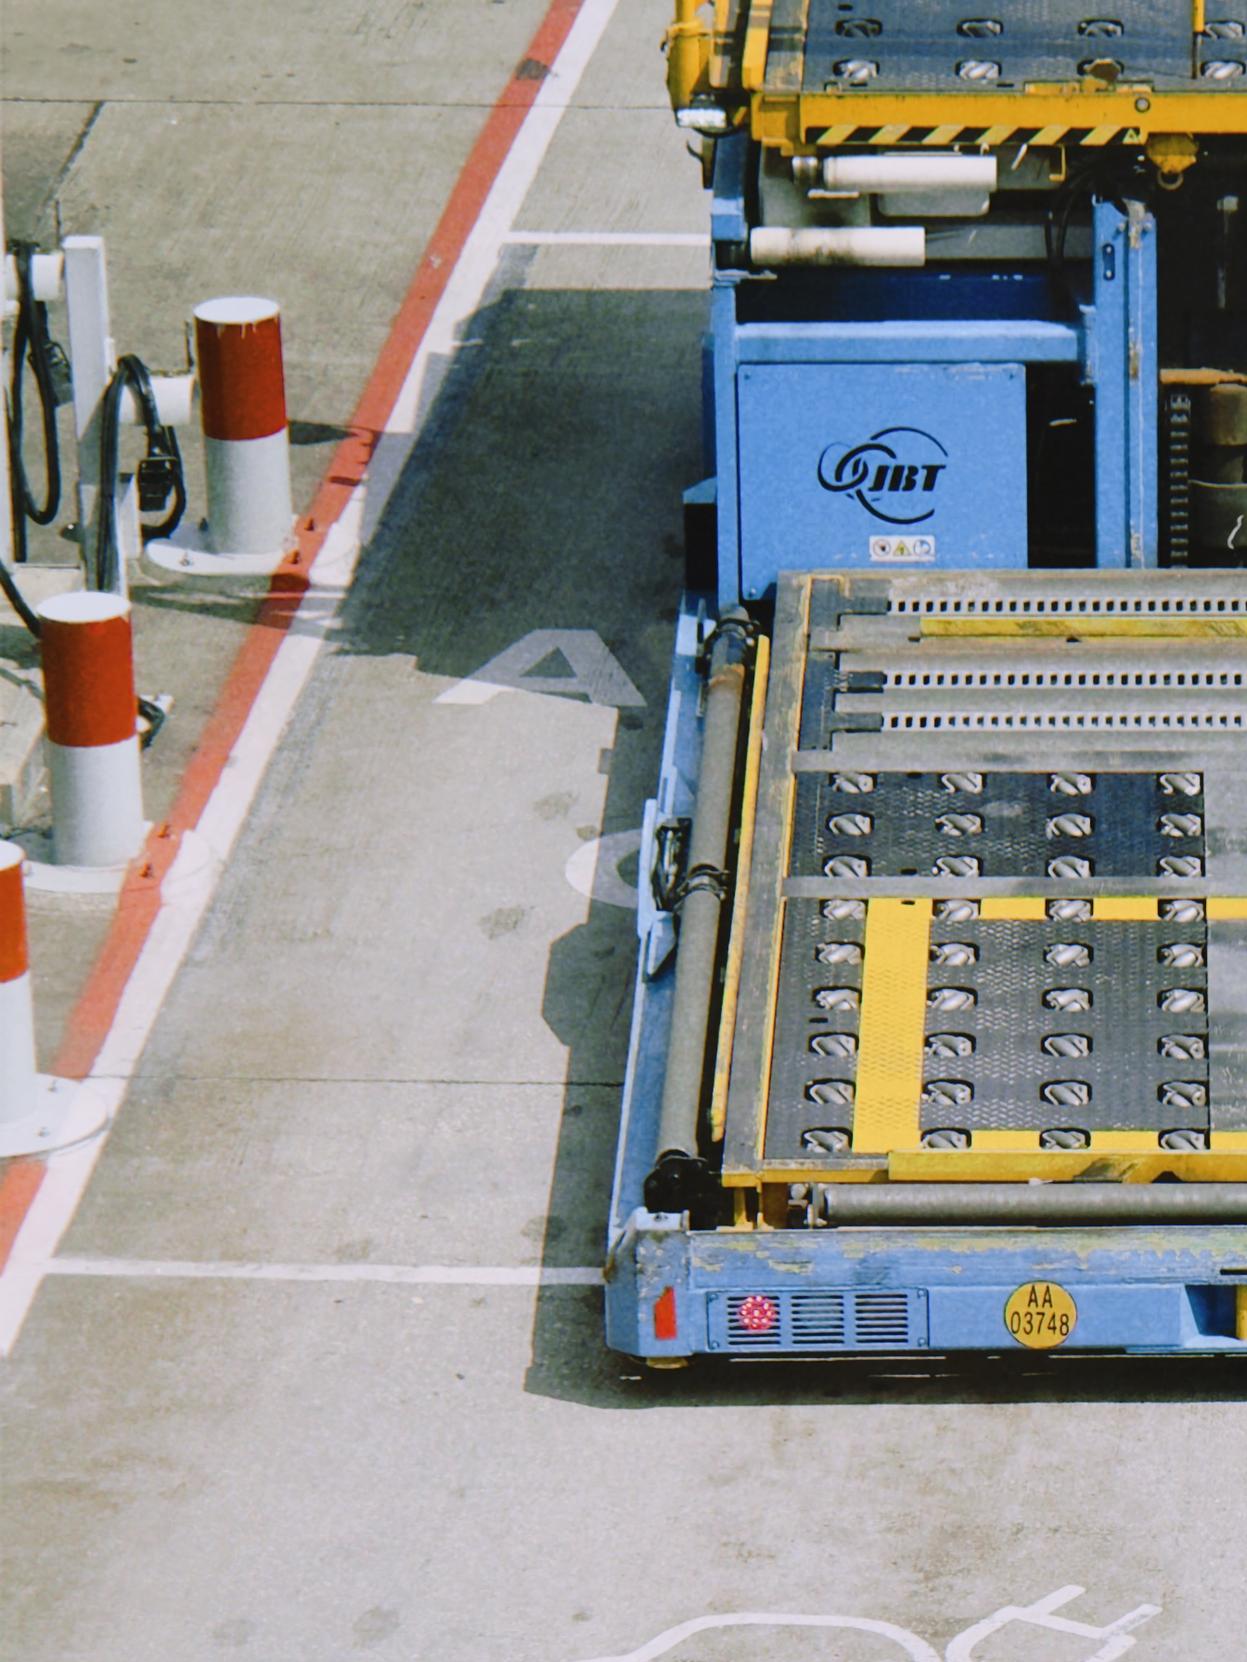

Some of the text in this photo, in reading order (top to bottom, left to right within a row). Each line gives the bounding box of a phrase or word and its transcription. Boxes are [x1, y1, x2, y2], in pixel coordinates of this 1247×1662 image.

[868, 464, 947, 492] JBT
[1028, 1285, 1053, 1309] AA
[1010, 1311, 1070, 1336] 03748
